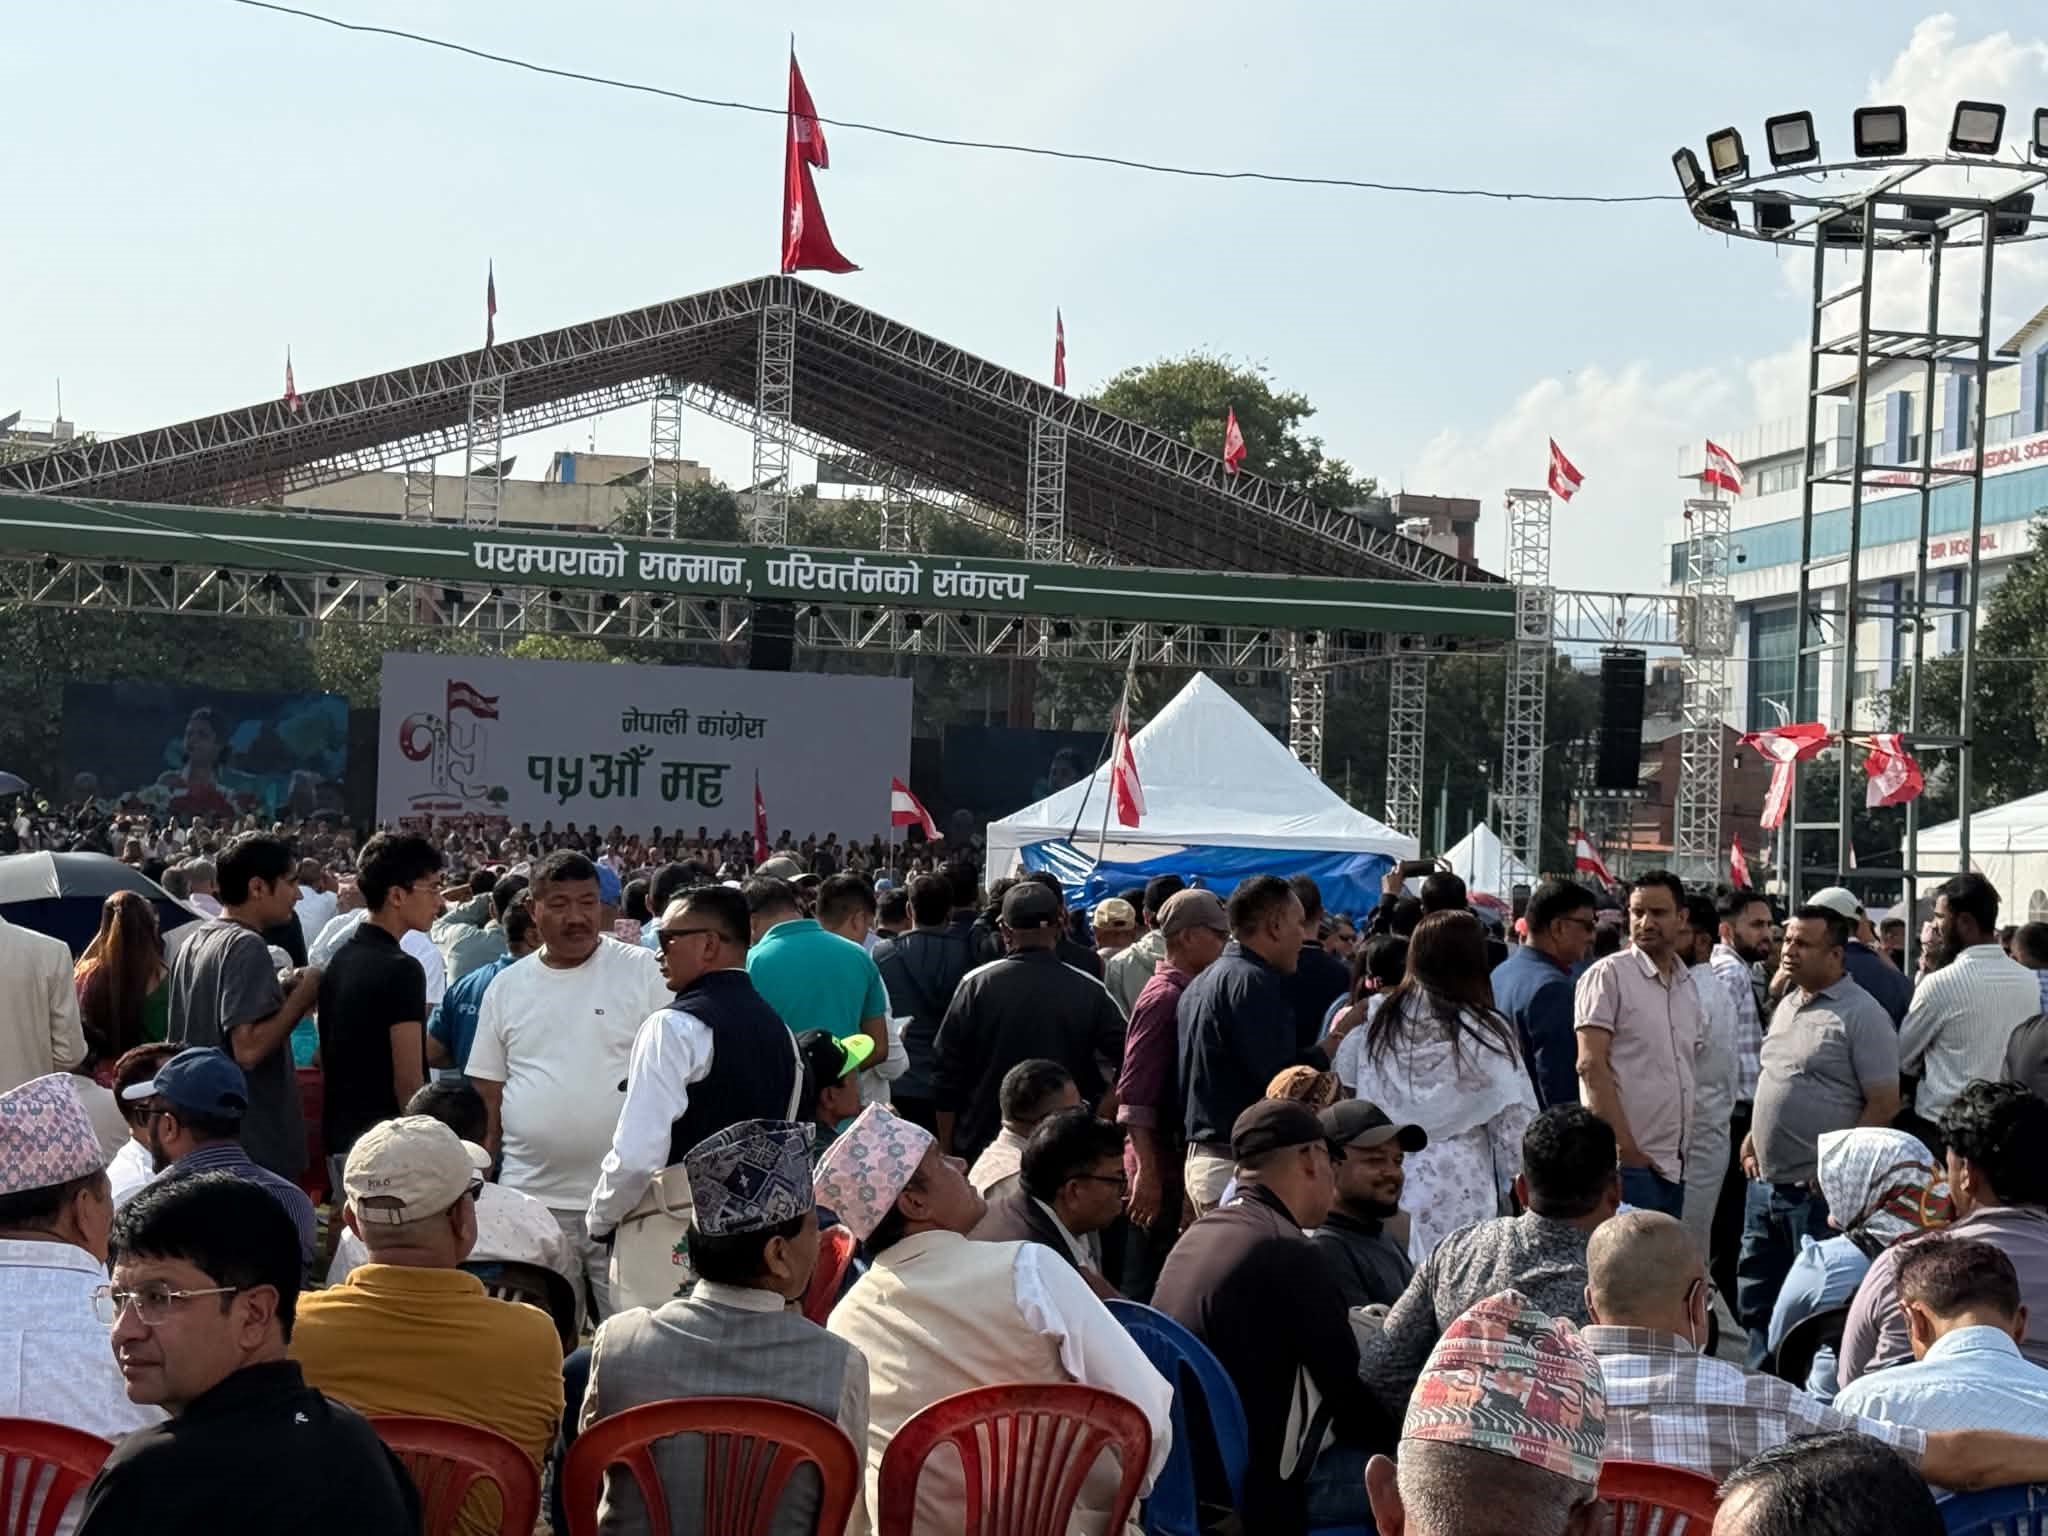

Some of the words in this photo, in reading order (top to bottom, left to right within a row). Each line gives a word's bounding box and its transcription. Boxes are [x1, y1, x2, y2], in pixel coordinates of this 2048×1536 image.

[473, 541, 629, 578] परम्पराको
[638, 551, 753, 593] सम्मान,
[766, 553, 923, 595] परिवर्तनको
[933, 561, 1030, 600] संकल्प
[621, 706, 691, 735] नेपाली
[697, 709, 768, 740] कांग्रेस
[660, 761, 732, 808] मह
